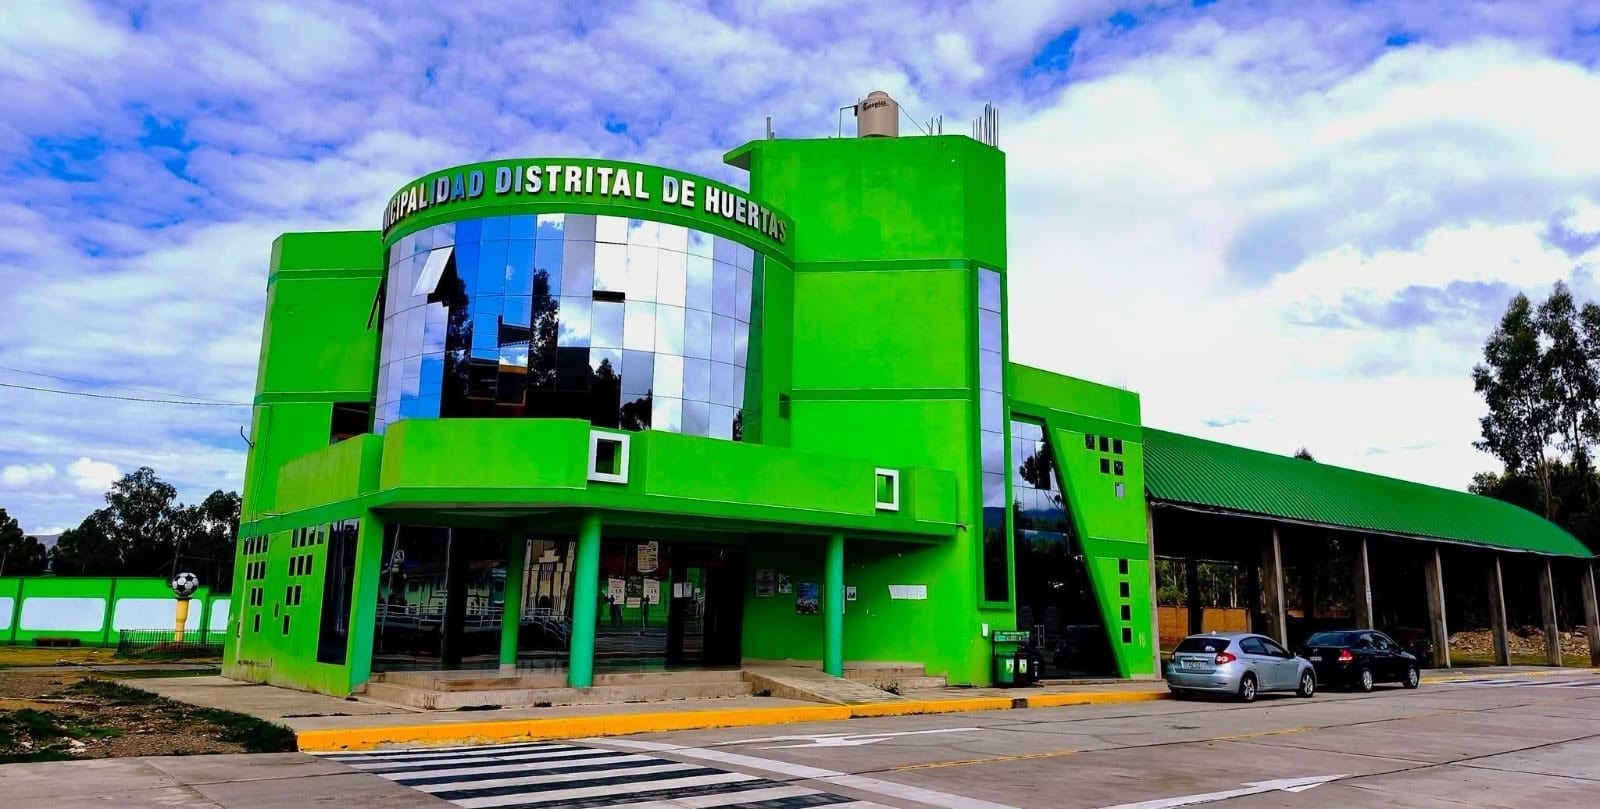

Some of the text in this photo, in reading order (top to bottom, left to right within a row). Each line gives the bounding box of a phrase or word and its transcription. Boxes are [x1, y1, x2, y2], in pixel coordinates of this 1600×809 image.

[495, 165, 650, 199] DISTRITAL
[662, 175, 696, 207] DE
[705, 185, 787, 243] HUERTAS
